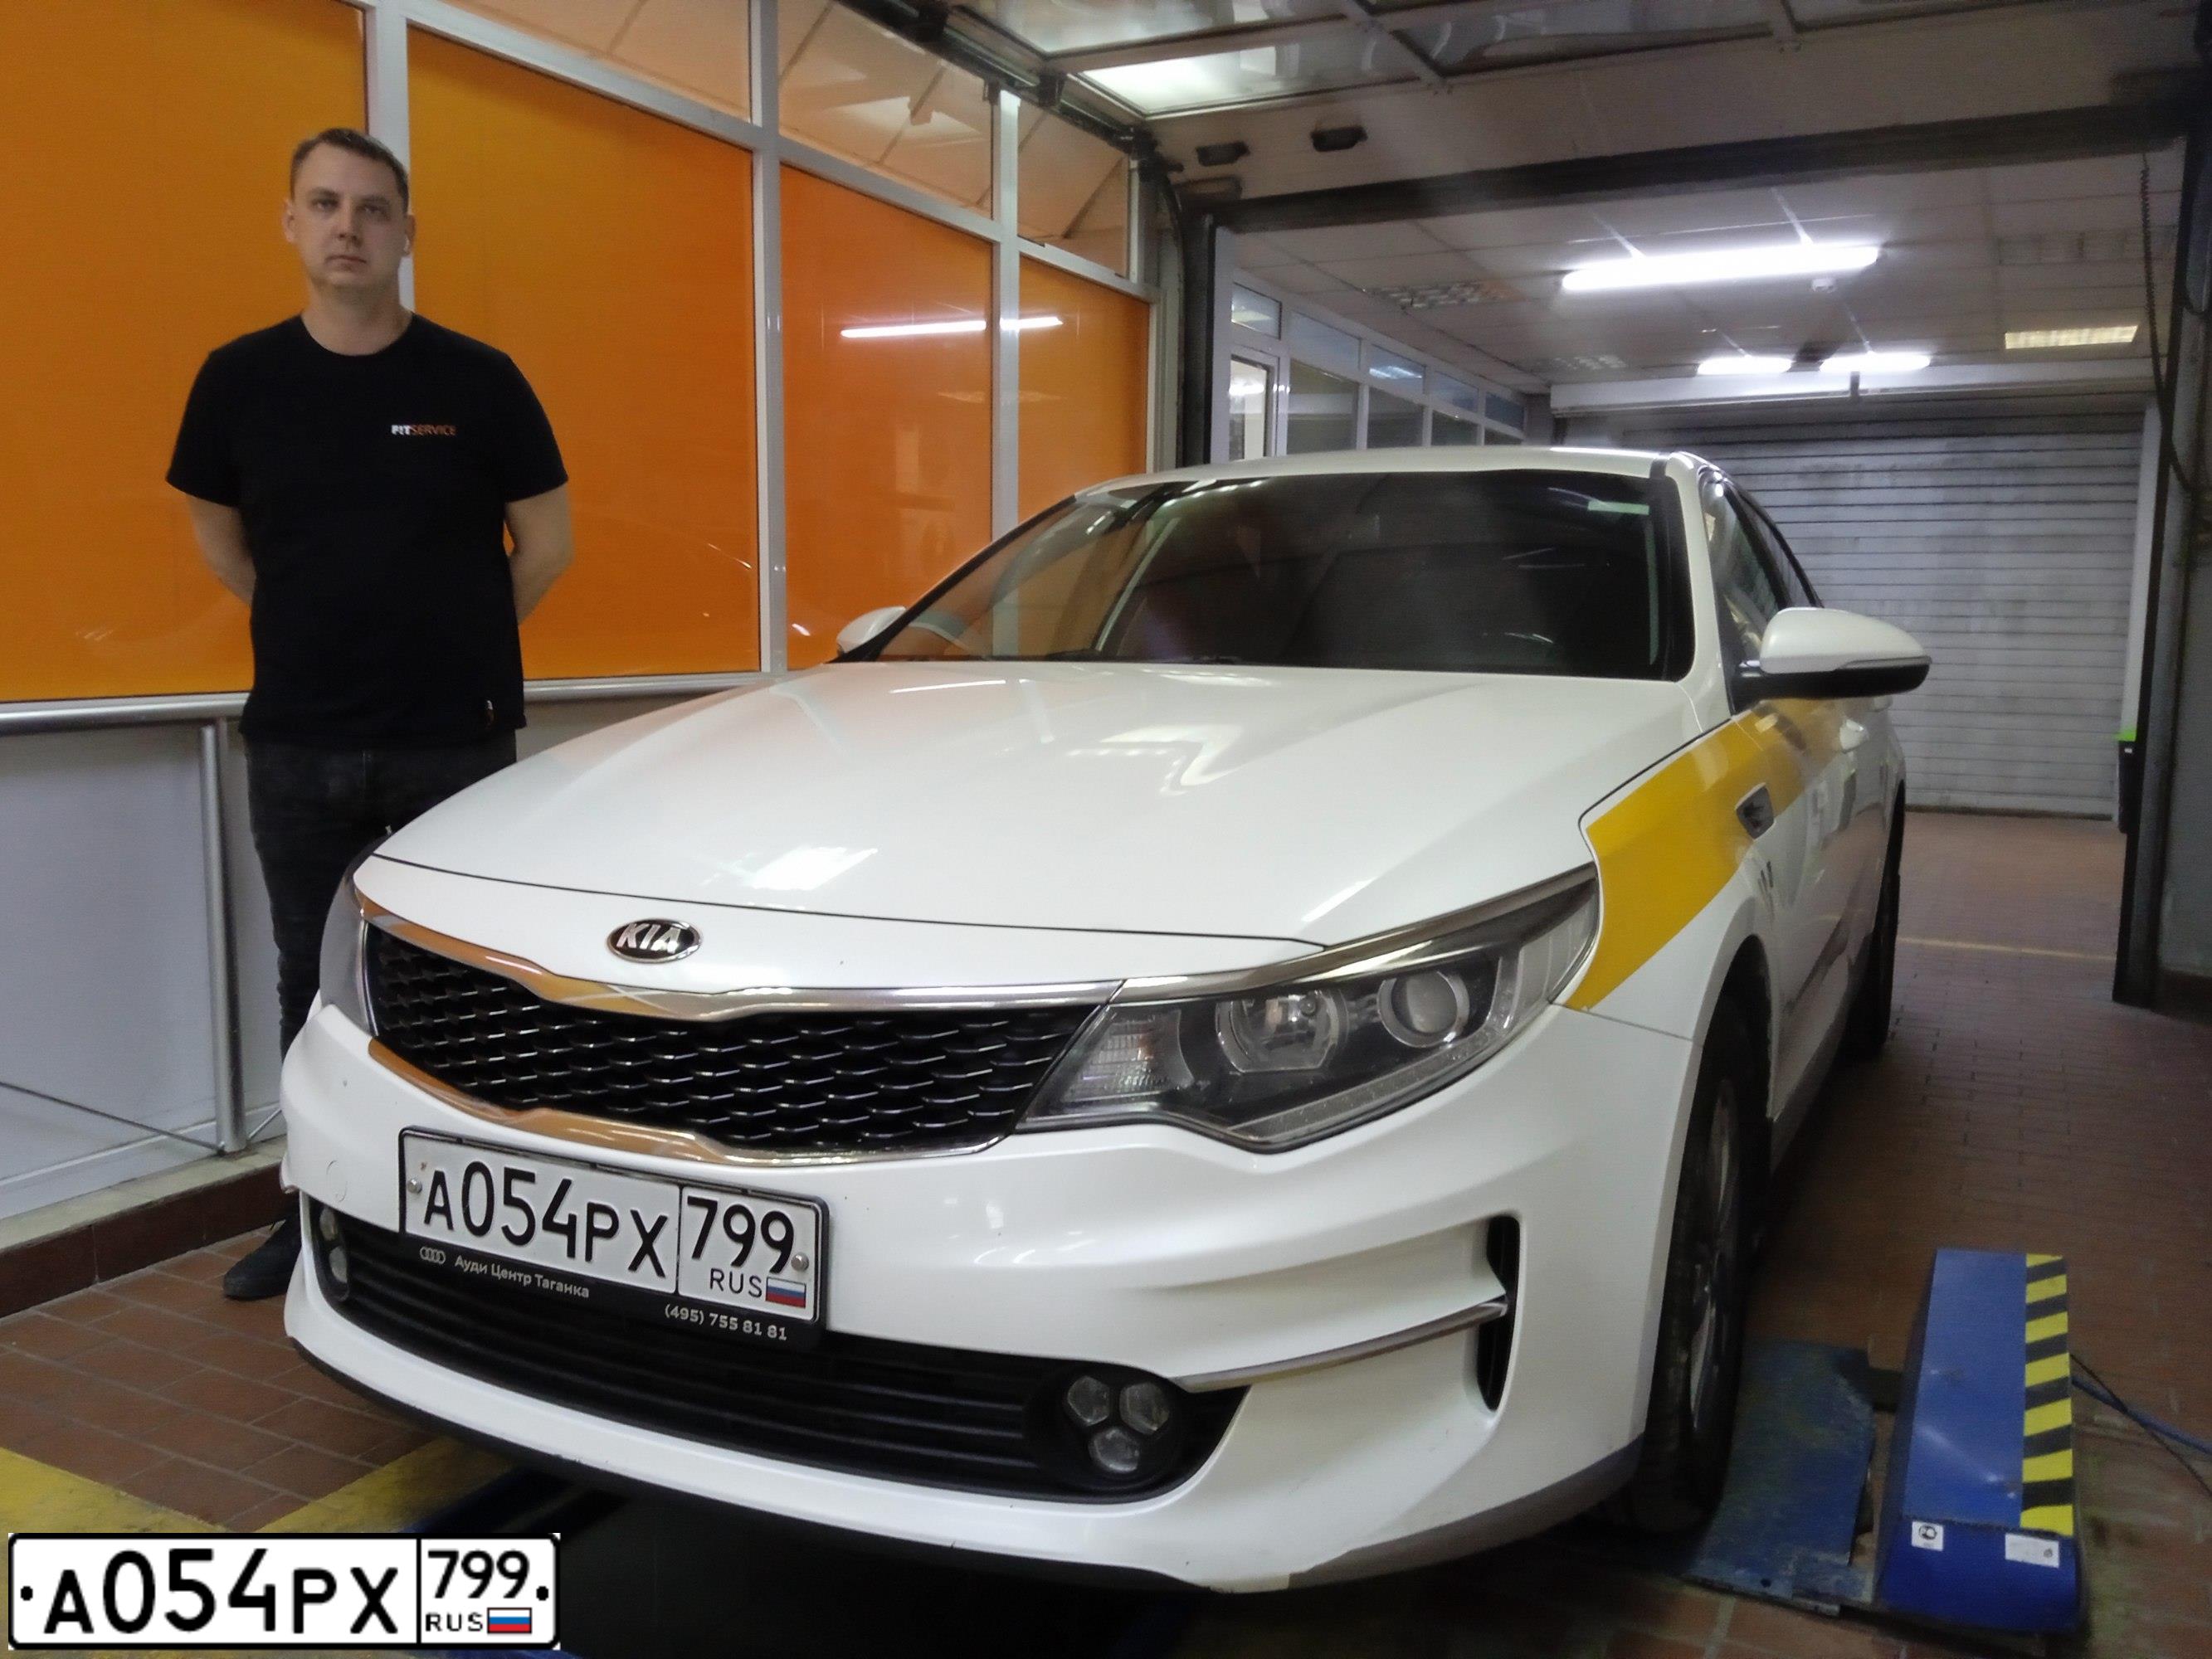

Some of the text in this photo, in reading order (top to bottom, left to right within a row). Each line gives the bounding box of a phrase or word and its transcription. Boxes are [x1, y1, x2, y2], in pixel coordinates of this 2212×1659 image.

[616, 923, 680, 954] KIA
[687, 1195, 795, 1274] 799
[455, 1255, 590, 1298] Ауди Центр Таганка
[709, 1267, 763, 1298] RUS
[665, 1303, 787, 1340] (495) 755 81 81
